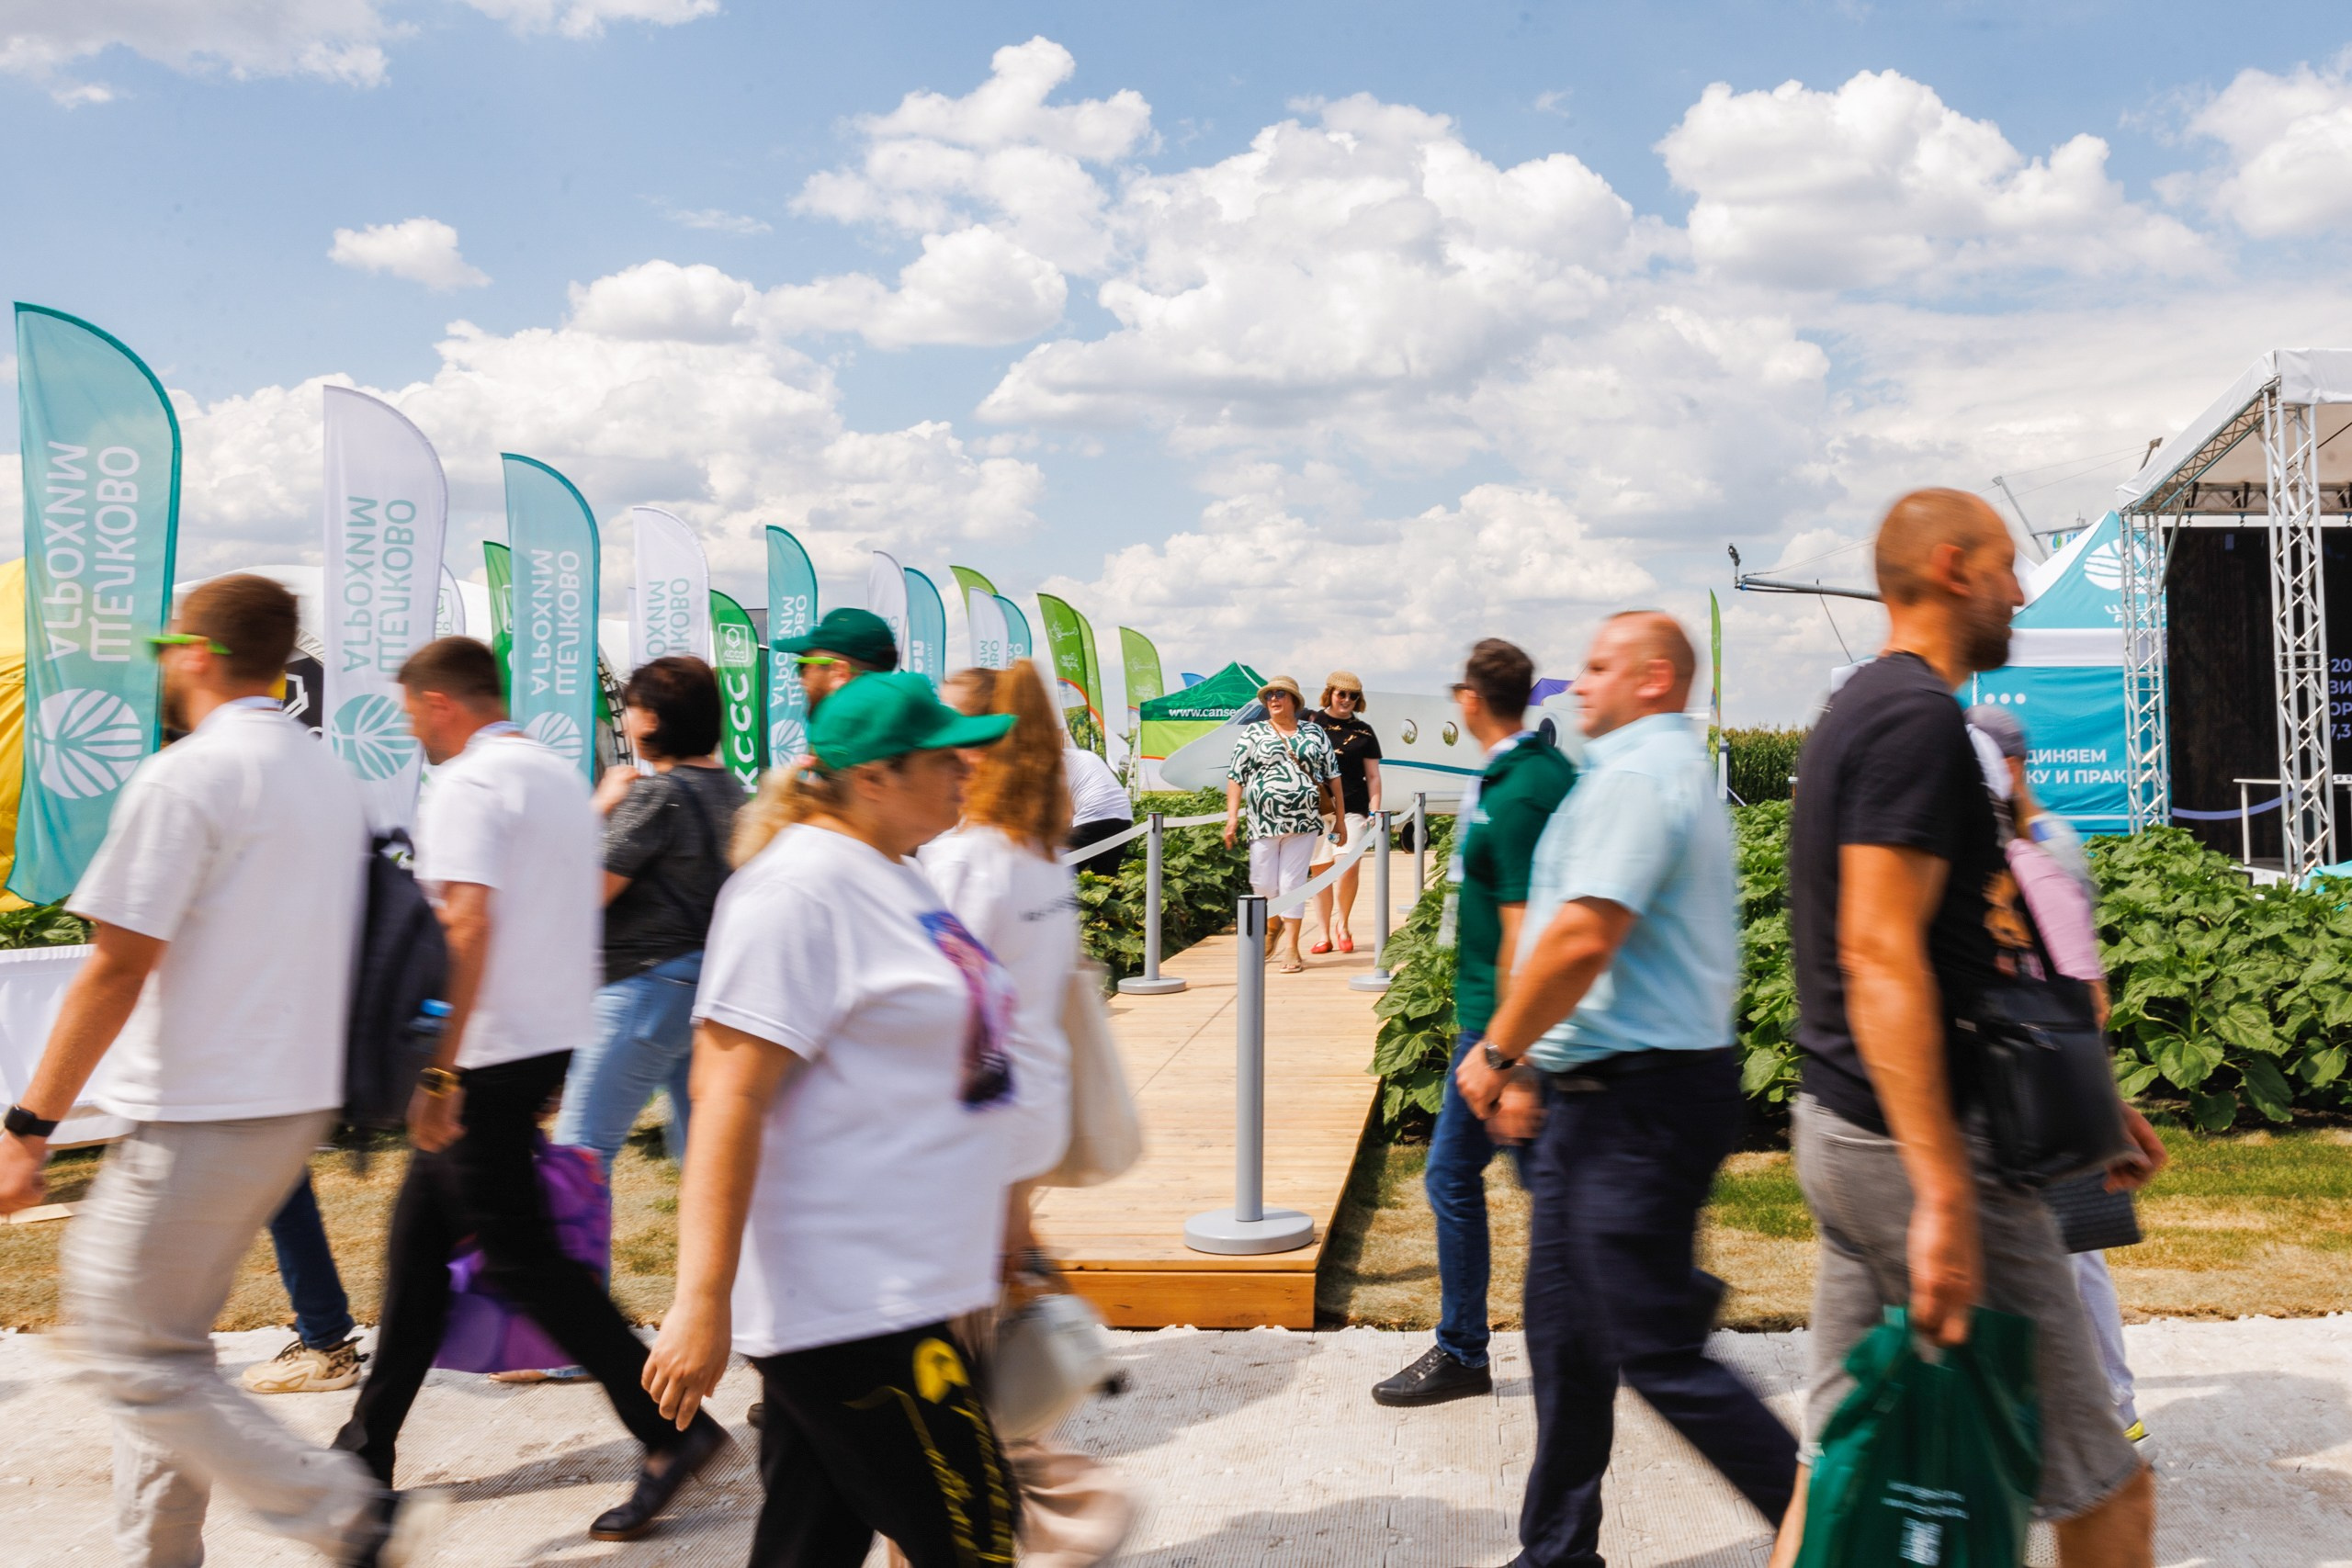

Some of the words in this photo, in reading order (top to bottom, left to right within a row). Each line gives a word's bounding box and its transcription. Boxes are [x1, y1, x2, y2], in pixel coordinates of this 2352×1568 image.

[1168, 708, 1238, 717] www.canse
[2025, 749, 2107, 765] ДИНЯЕМ
[2052, 770, 2069, 784] И
